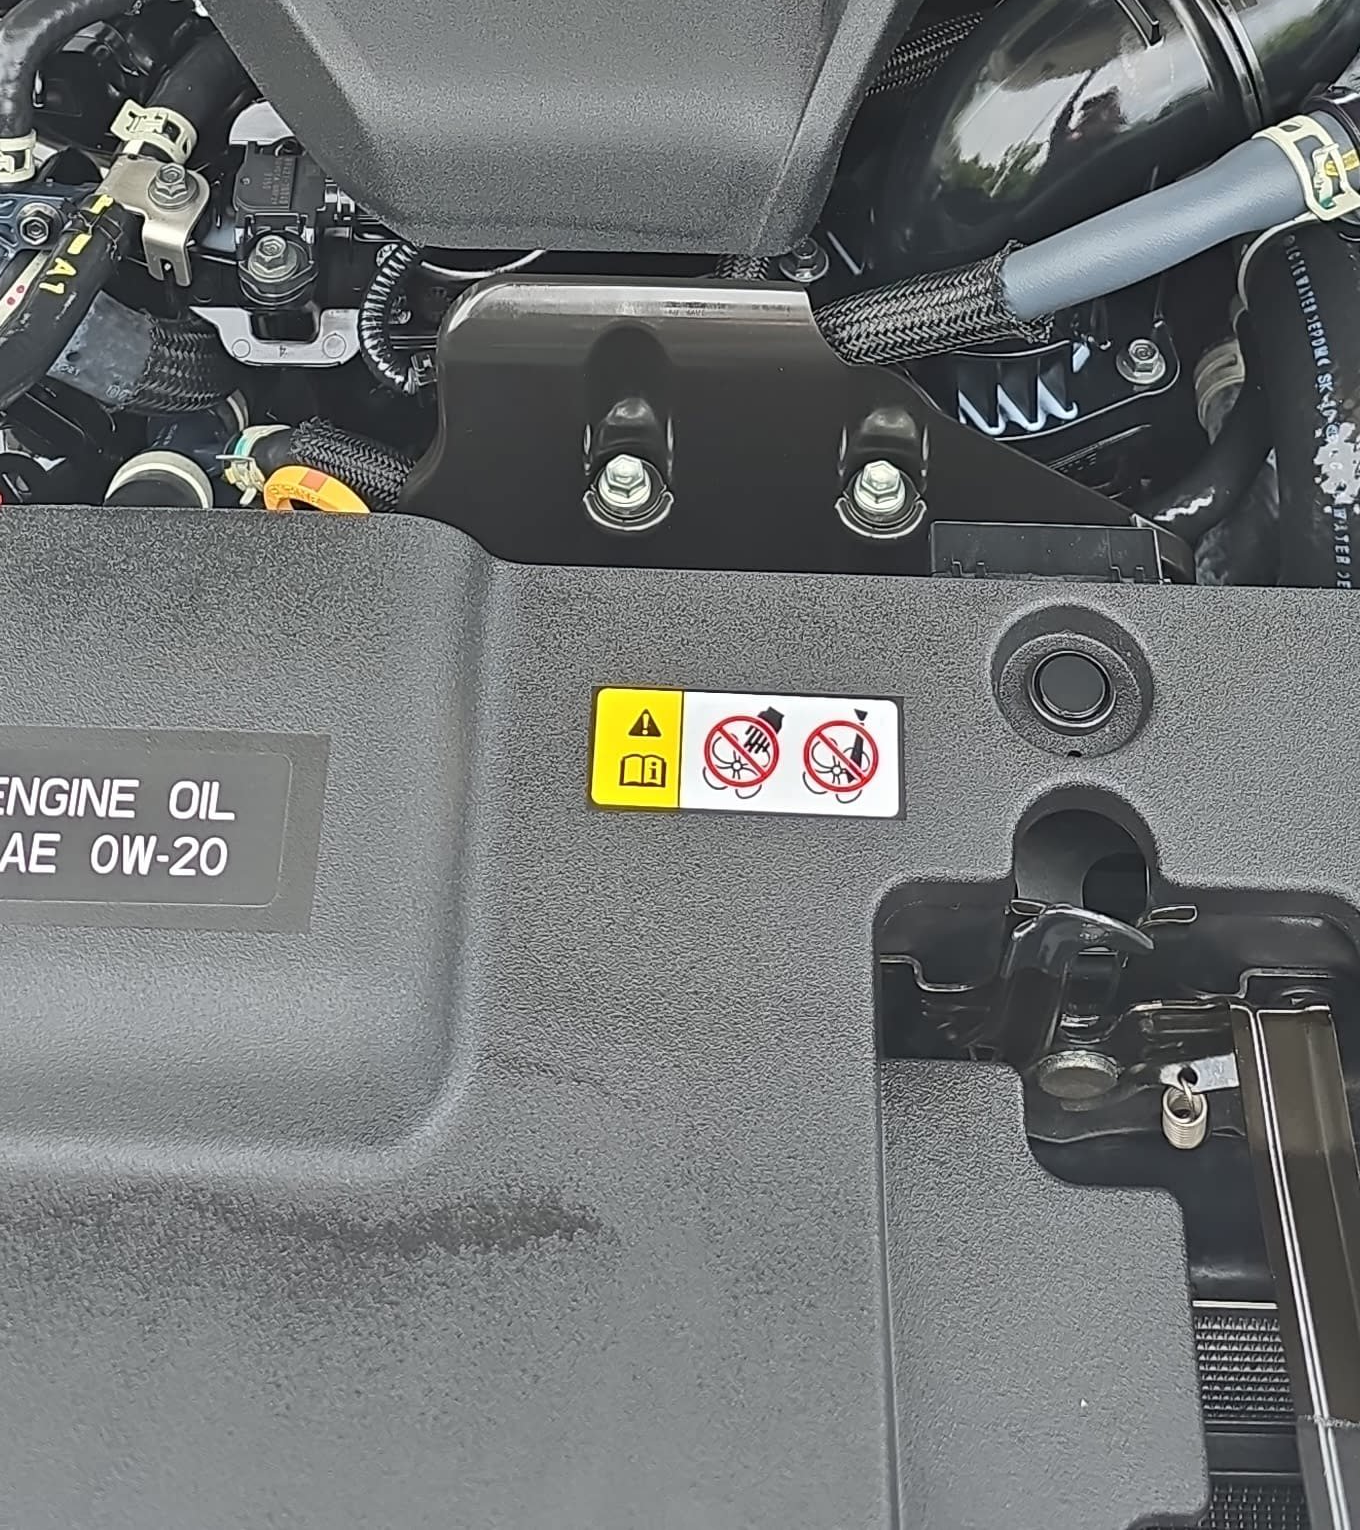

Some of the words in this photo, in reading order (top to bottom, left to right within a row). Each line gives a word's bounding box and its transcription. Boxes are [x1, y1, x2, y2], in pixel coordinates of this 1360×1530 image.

[39, 257, 77, 295] A1
[168, 780, 236, 822] OIL
[89, 835, 230, 877] 0W-20
